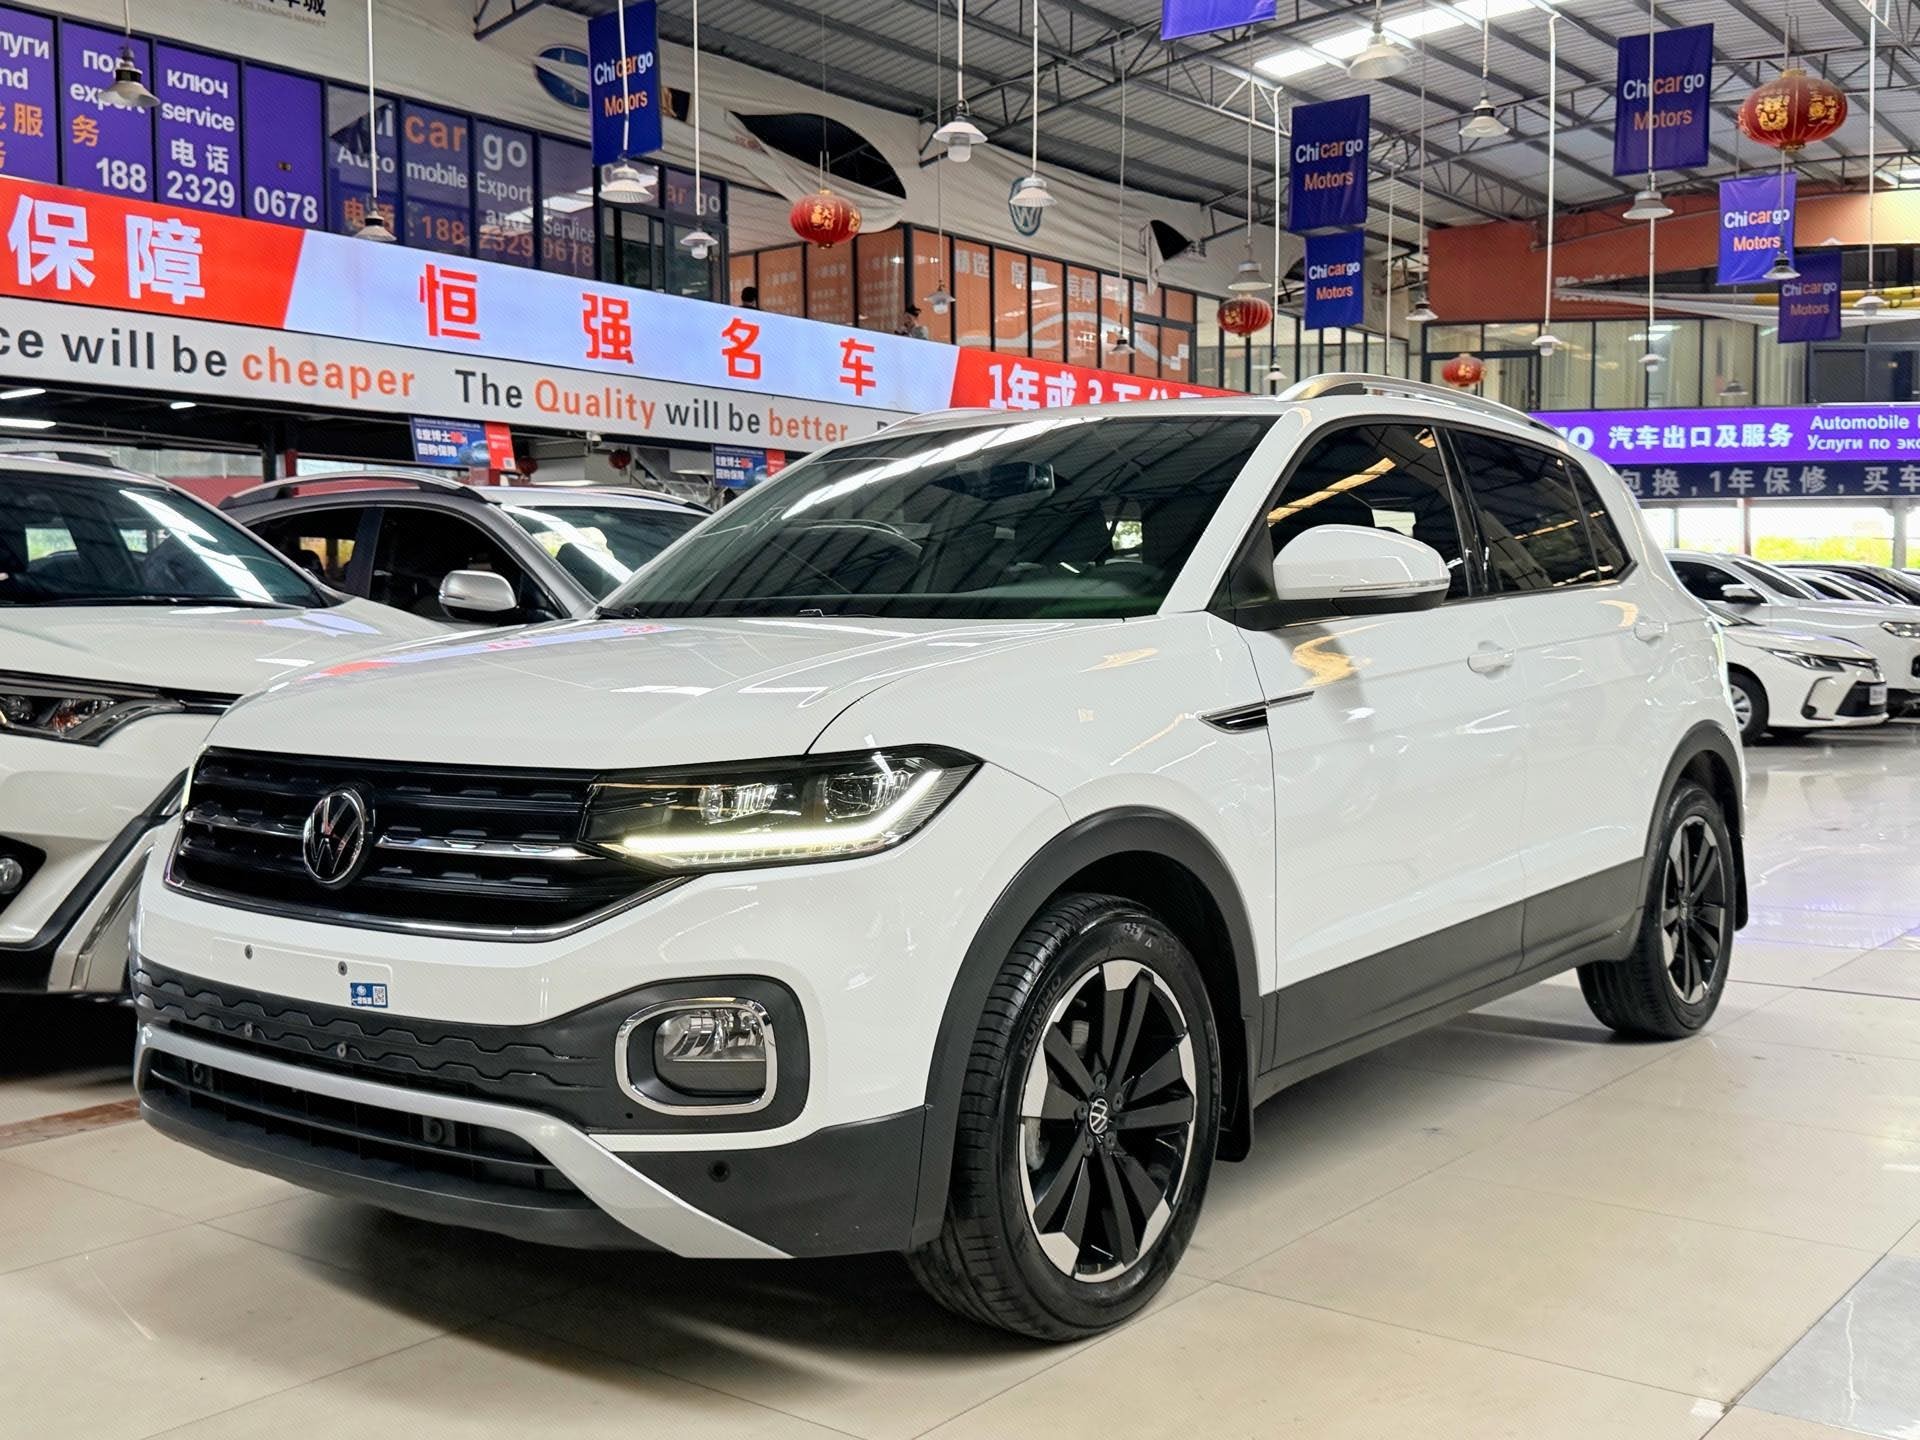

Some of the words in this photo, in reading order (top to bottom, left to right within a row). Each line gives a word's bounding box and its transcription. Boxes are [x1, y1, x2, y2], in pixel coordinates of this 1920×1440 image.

[166, 69, 229, 99] ключ
[161, 103, 235, 132] service
[404, 114, 467, 152] car
[483, 134, 528, 171] go
[1295, 138, 1364, 164] Chicargo
[170, 138, 230, 175] 电话
[95, 156, 147, 193] 188
[166, 170, 236, 209] 2329
[253, 186, 319, 224] 0678
[406, 160, 468, 189] mobile
[476, 174, 533, 203] Export
[1304, 169, 1354, 191] Motors
[1724, 207, 1791, 229] Chicargo
[7, 193, 206, 305] 保障
[1733, 235, 1781, 253] Motors
[1309, 261, 1361, 281] Chicargo
[1316, 284, 1354, 301] Motors
[1782, 280, 1838, 298] Chicargo
[1789, 302, 1830, 317] Motors
[61, 327, 155, 370] will
[172, 335, 228, 378] be
[242, 346, 416, 400] cheaper
[455, 369, 523, 409] The
[533, 378, 656, 430] Quality
[665, 399, 719, 437] will
[729, 402, 761, 434] be
[768, 407, 848, 442] better
[1810, 415, 1910, 431] Automobile
[1608, 423, 1794, 451] 汽车出口及服务
[1807, 434, 1864, 453] Услуги
[1869, 439, 1892, 450] по
